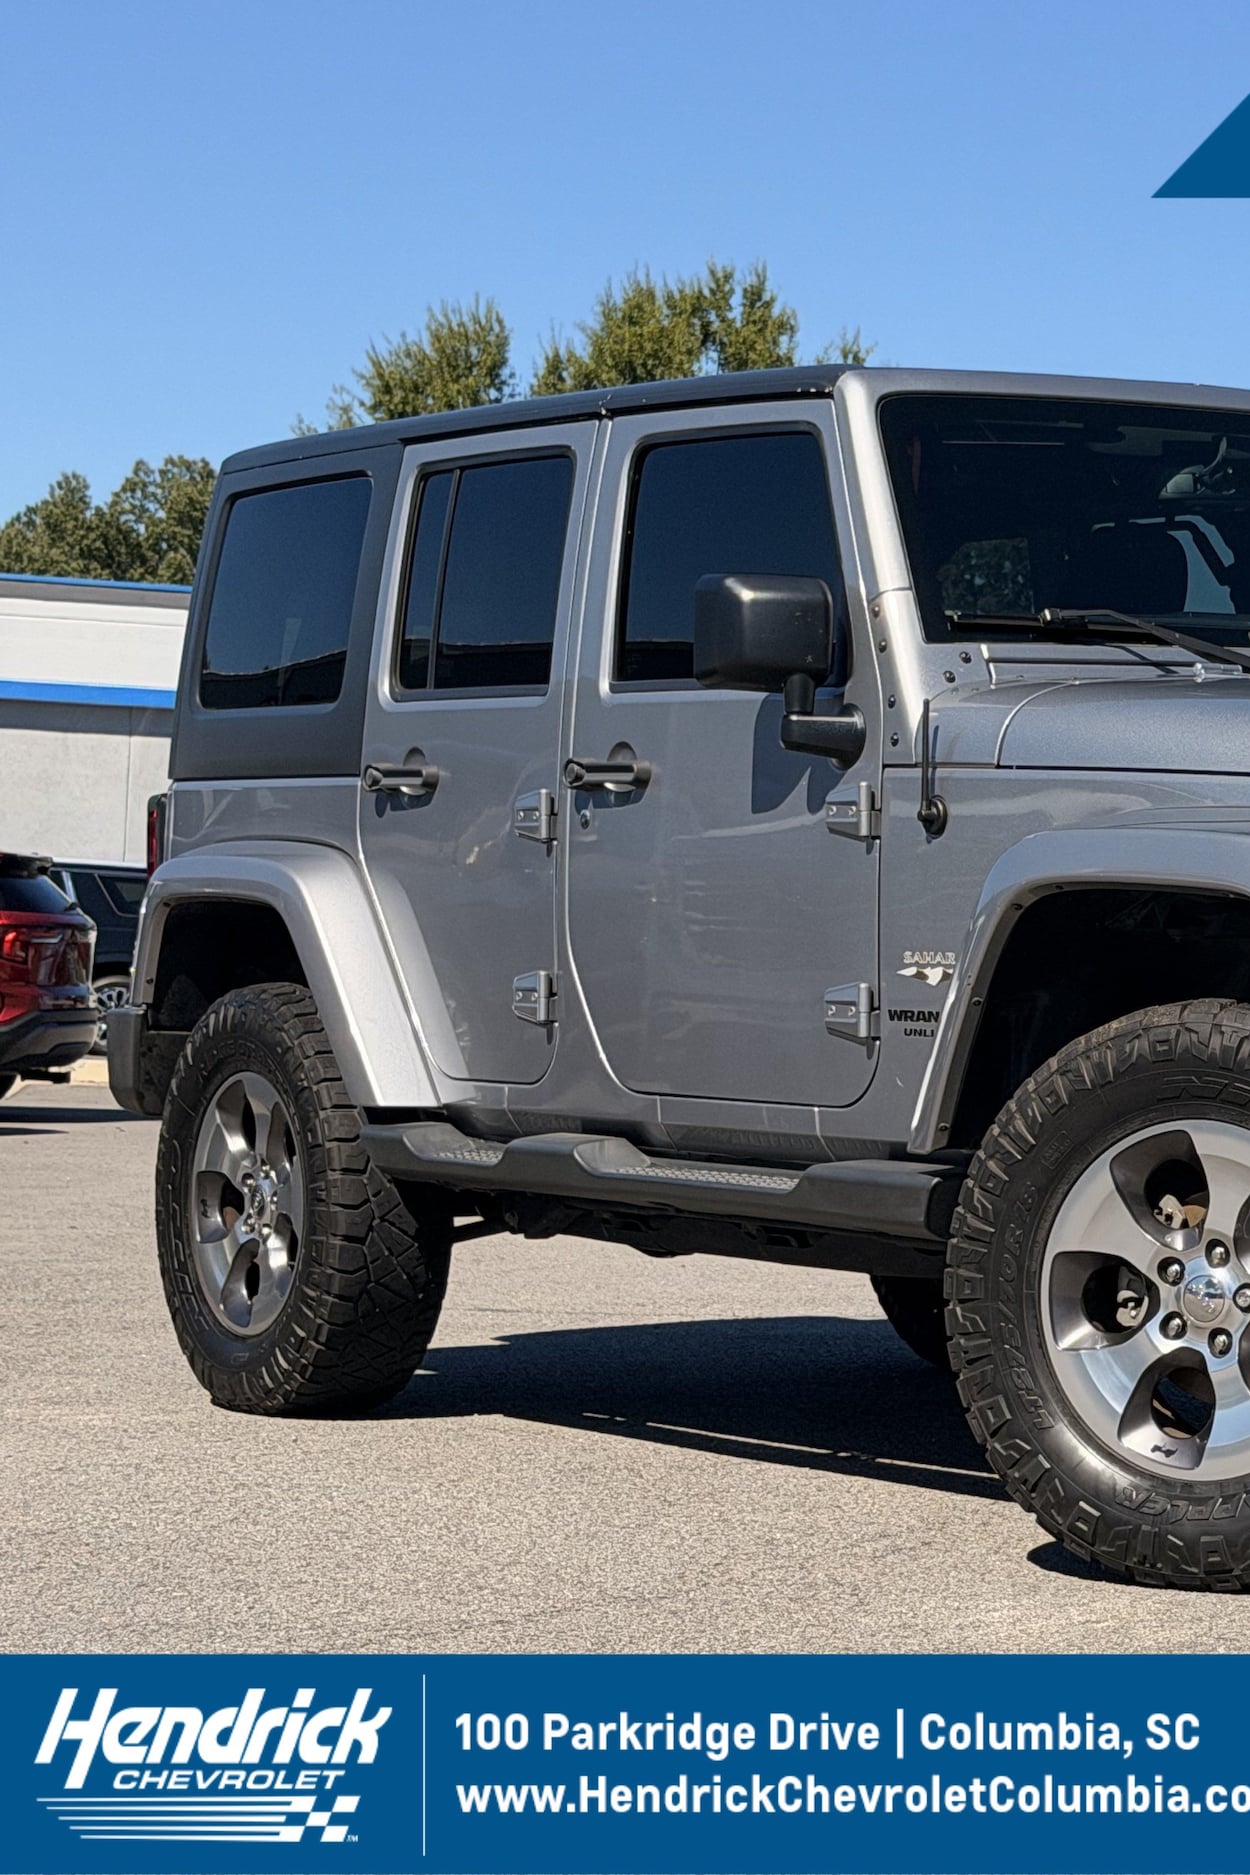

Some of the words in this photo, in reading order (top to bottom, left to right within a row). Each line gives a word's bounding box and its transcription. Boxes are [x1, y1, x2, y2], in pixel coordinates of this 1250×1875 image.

[903, 951, 956, 965] SAHAR
[887, 1009, 941, 1023] WRAN
[903, 1027, 936, 1038] UNLI
